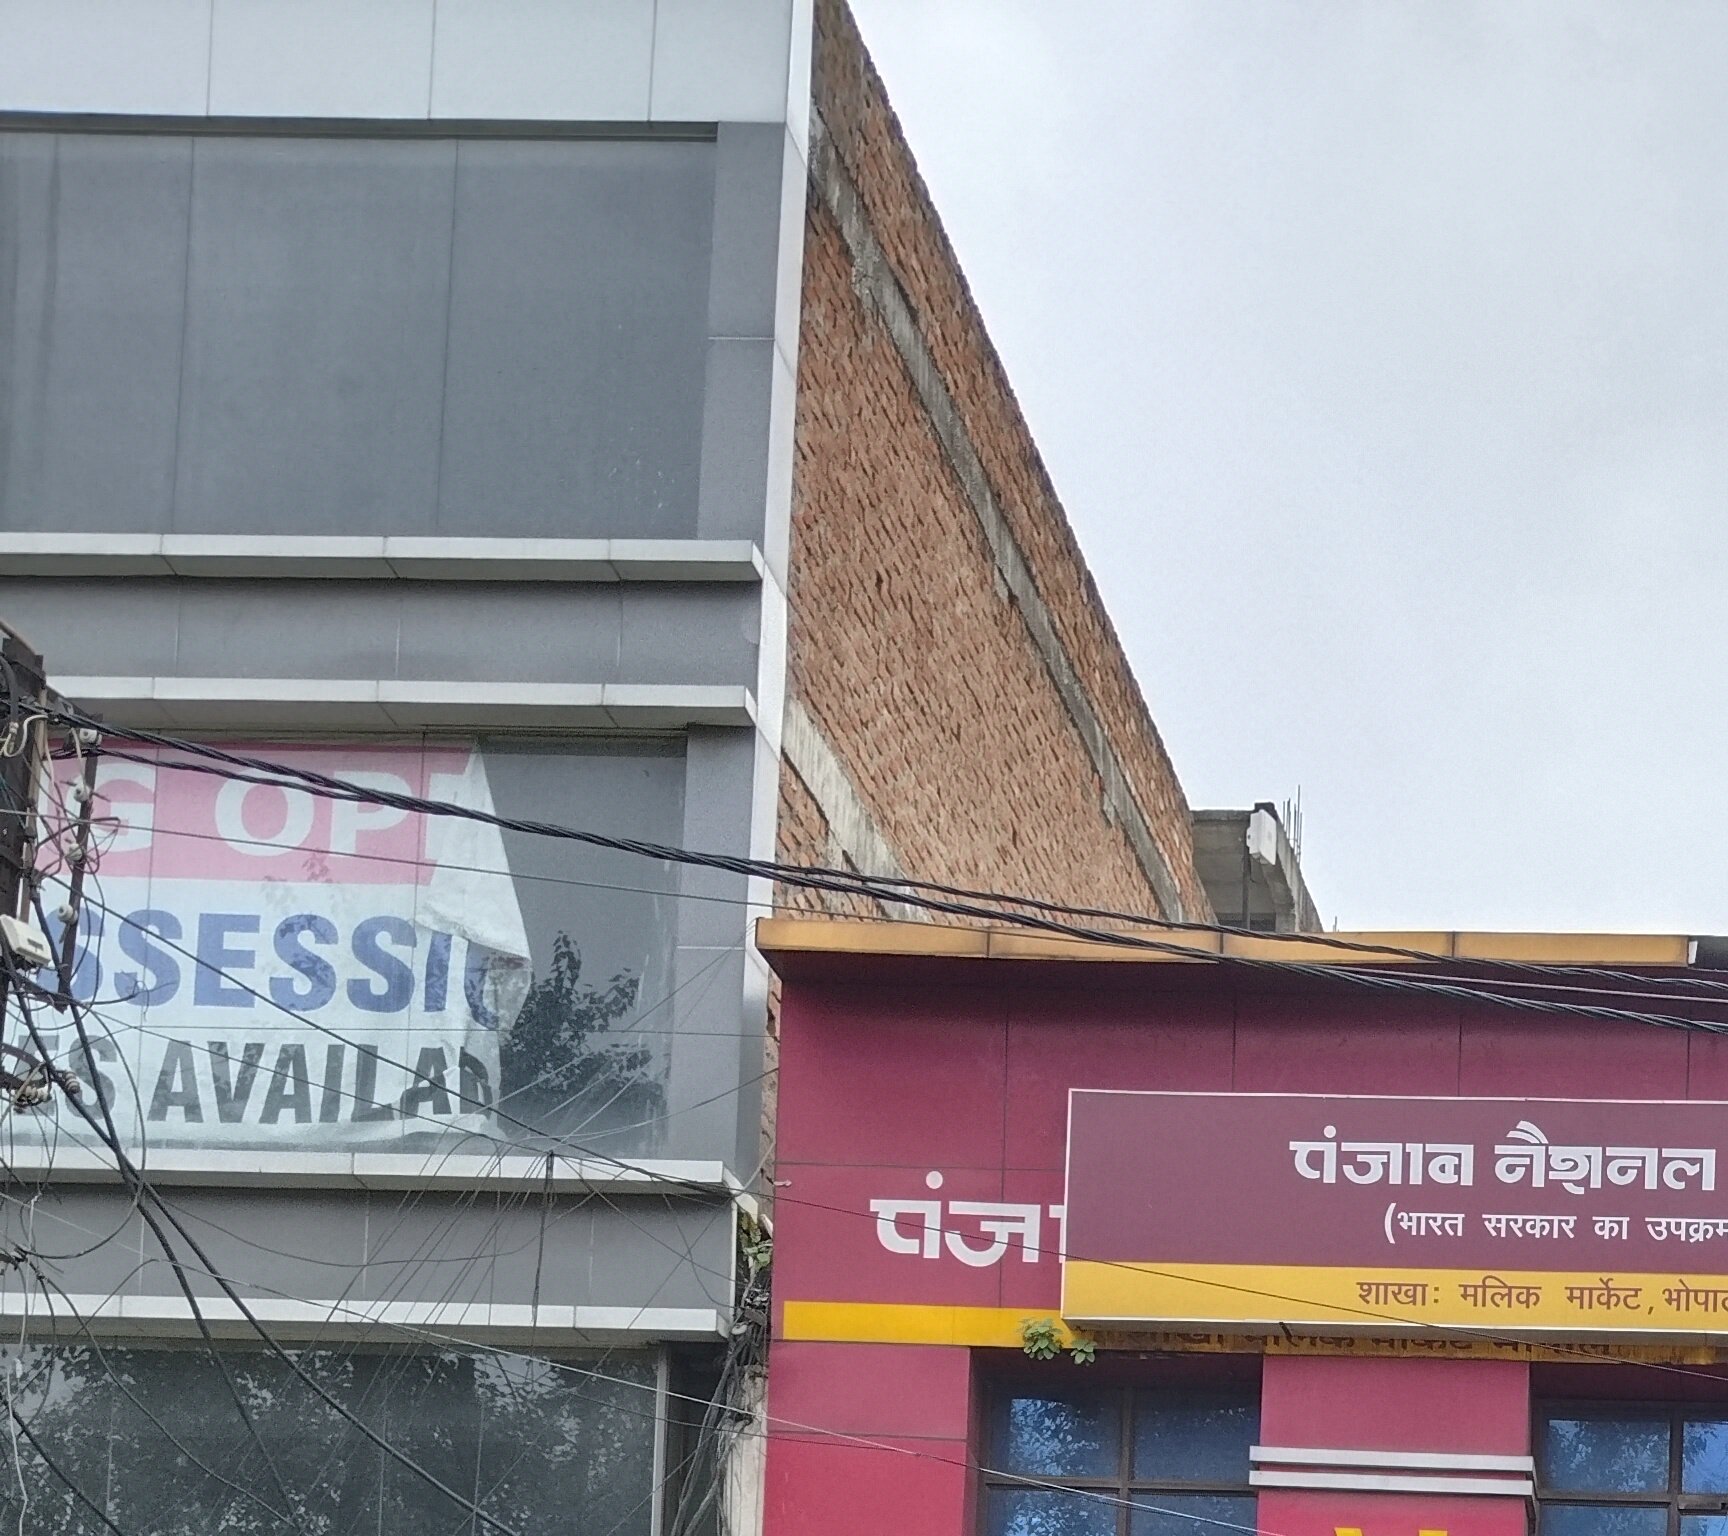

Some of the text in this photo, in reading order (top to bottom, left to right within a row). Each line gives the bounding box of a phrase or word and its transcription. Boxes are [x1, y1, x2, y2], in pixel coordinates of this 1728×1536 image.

[1289, 1125, 1474, 1186] पंजाब
[1495, 1120, 1716, 1194] नैशनल
[1383, 1202, 1465, 1244] (भारत
[1483, 1214, 1577, 1240] सरकार
[1593, 1214, 1629, 1240] का
[1459, 1276, 1542, 1310] मलिक
